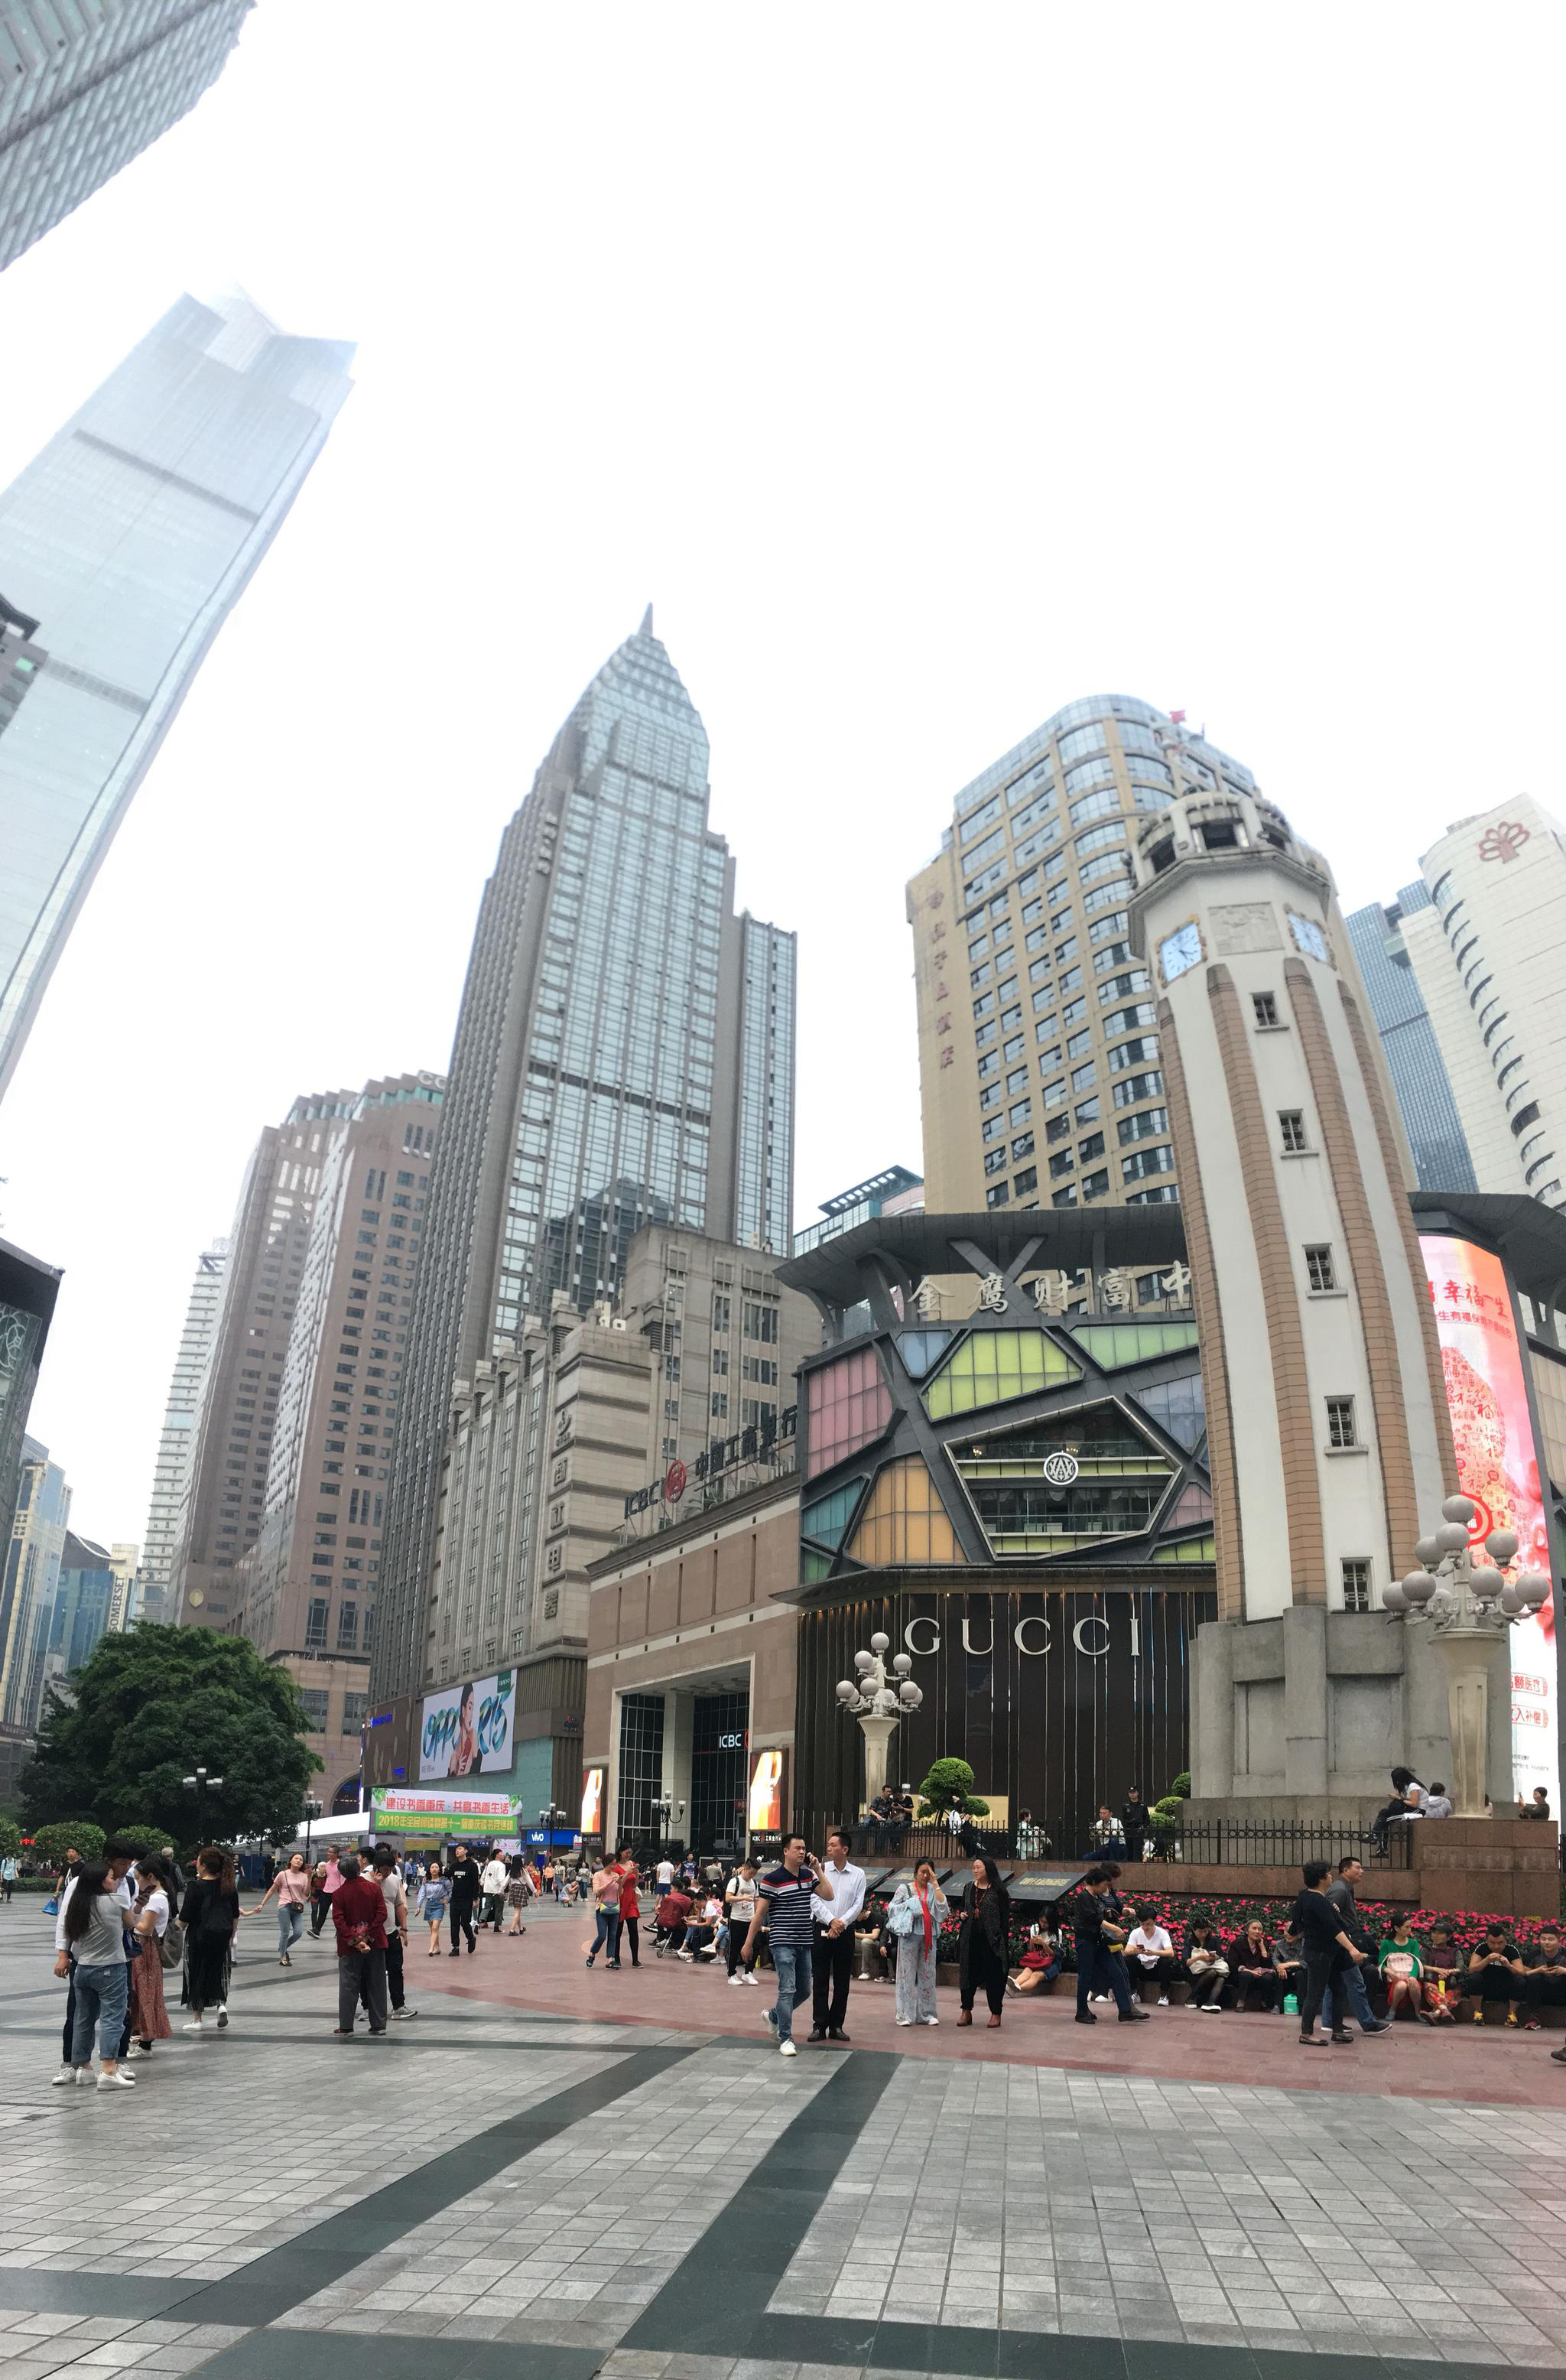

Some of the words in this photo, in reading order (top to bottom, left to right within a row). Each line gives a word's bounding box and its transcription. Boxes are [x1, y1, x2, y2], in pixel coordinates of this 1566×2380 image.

[908, 1260, 1191, 1314] 金鹰财富中
[624, 1480, 659, 1520] ICBC
[695, 1405, 798, 1481] 中国工商银行
[109, 1575, 125, 1634] SOMERSET
[905, 1617, 1139, 1657] GUCCI
[720, 1734, 742, 1748] ICBC
